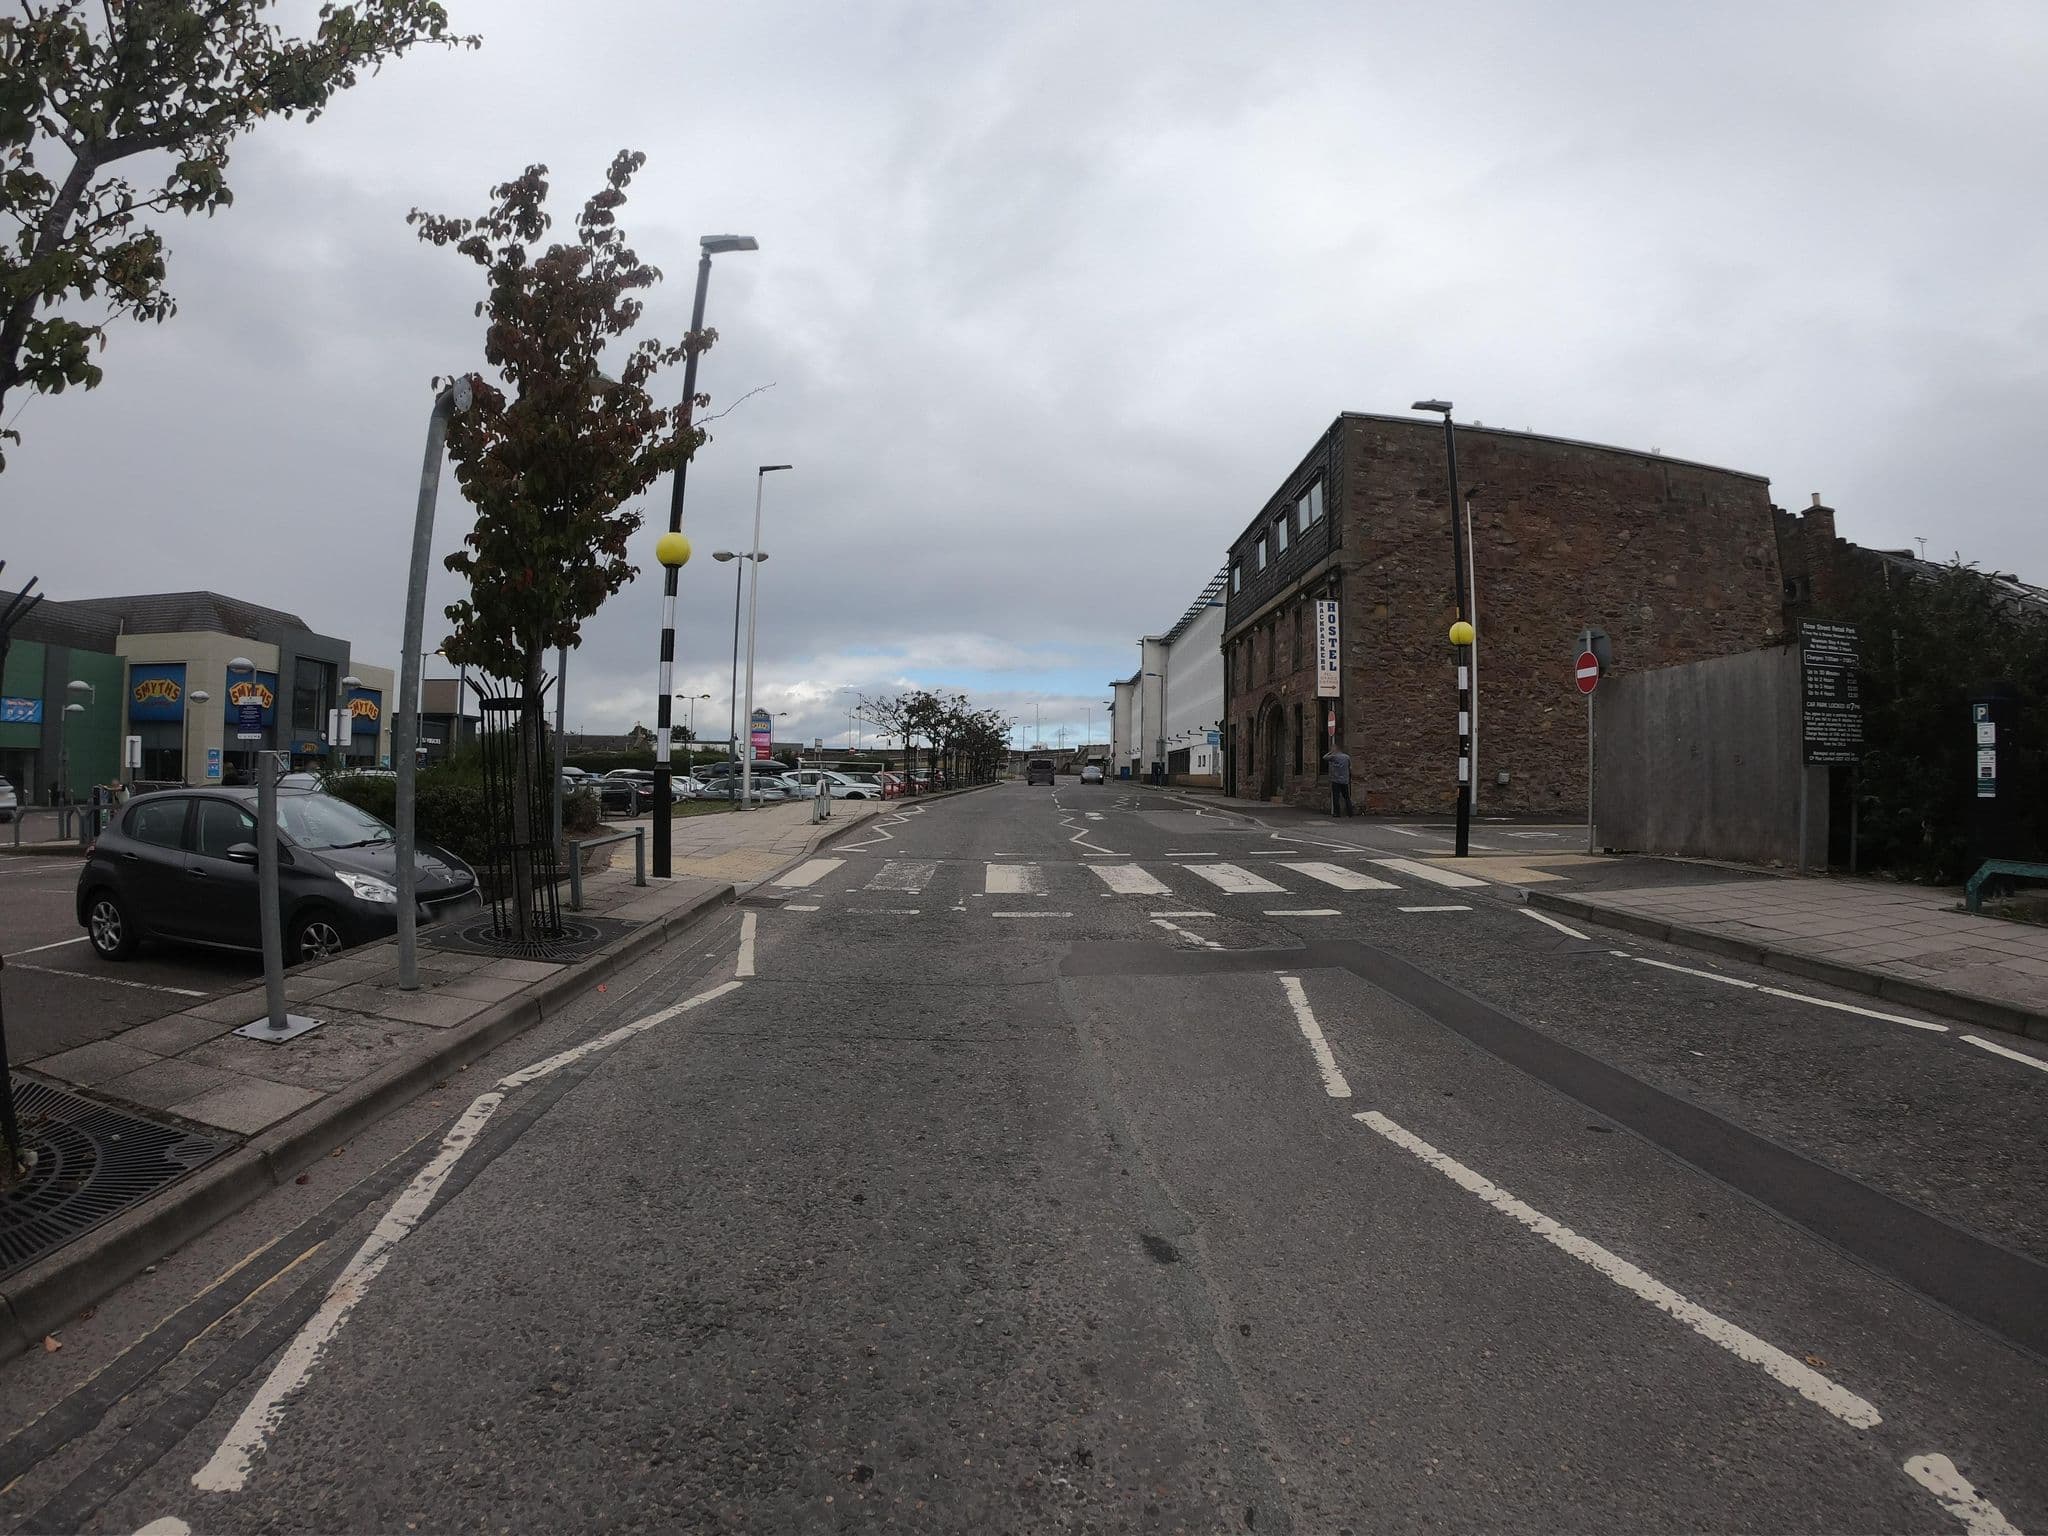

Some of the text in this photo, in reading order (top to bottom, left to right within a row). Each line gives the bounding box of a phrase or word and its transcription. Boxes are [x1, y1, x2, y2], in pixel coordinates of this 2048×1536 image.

[1327, 602, 1337, 672] HOSTEL
[134, 681, 180, 701] SMYTHS
[1977, 706, 1987, 721] P
